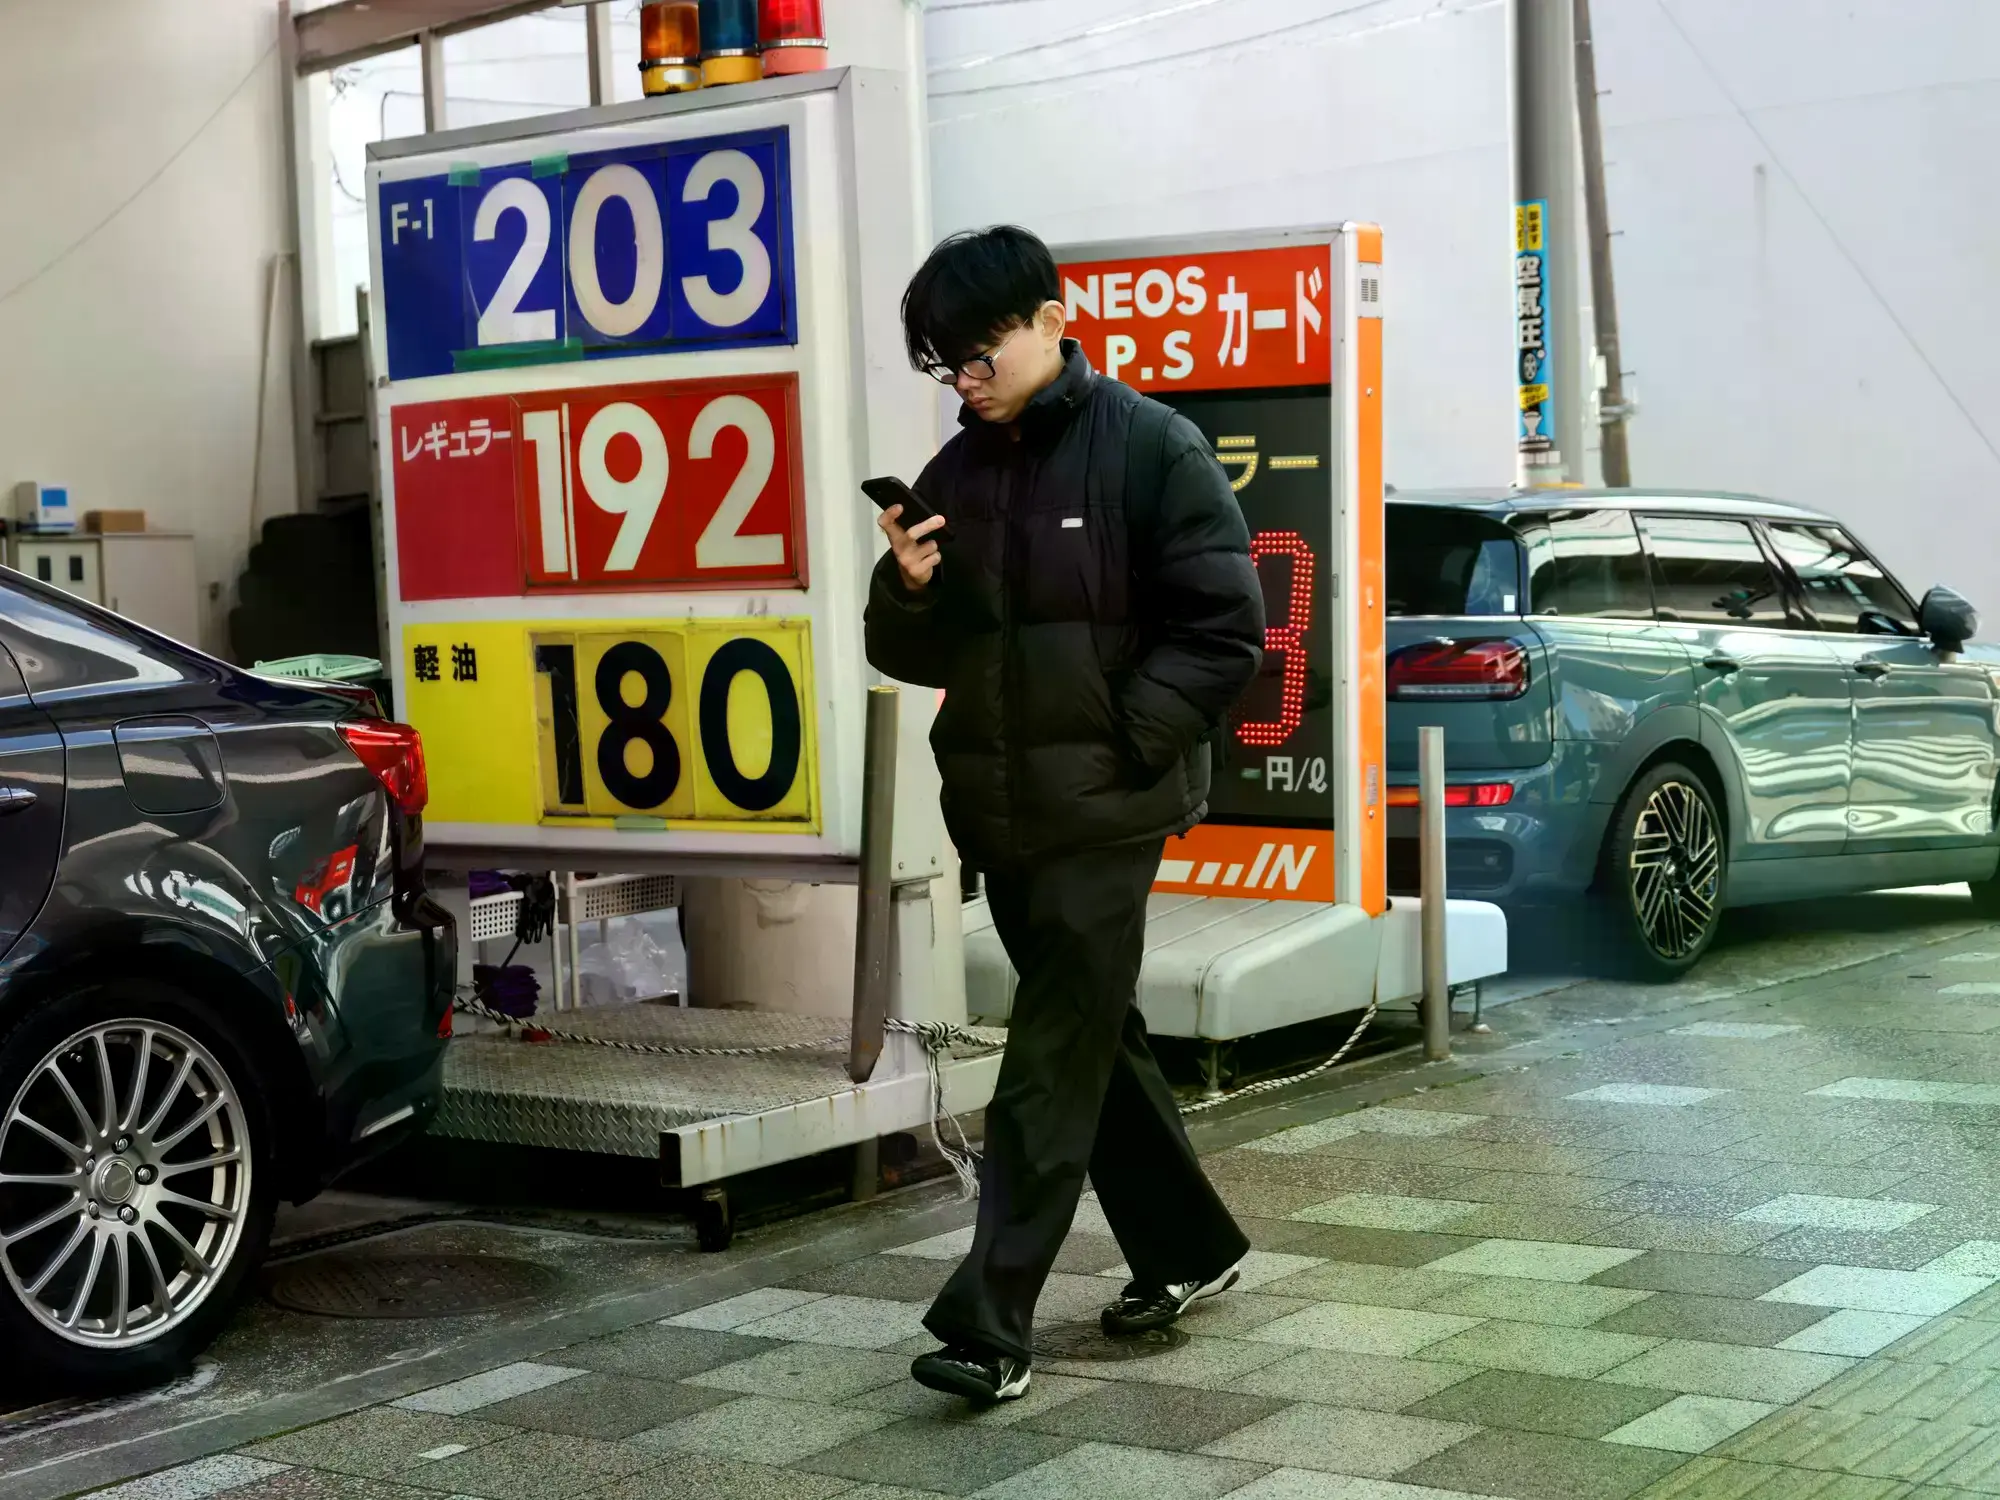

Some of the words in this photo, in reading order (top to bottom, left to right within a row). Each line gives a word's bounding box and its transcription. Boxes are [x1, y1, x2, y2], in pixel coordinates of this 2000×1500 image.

[391, 198, 434, 245] F-1
[472, 148, 772, 347] 203
[1217, 265, 1323, 367] カード
[400, 418, 511, 462] レギュラー
[522, 394, 785, 574] 192
[413, 642, 478, 683] 軽油
[535, 637, 801, 811] 180
